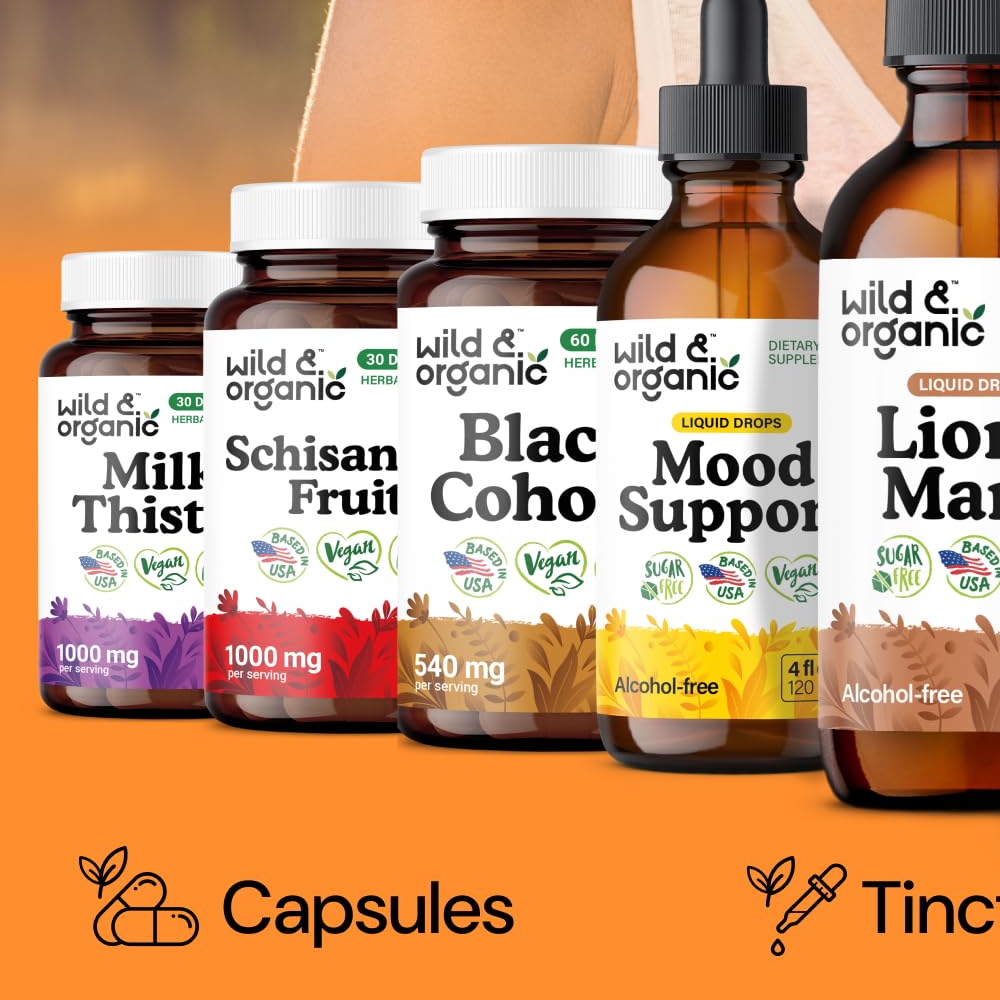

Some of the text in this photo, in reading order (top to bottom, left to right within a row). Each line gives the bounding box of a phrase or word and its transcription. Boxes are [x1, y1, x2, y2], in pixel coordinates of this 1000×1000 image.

[842, 281, 912, 314] wild
[416, 329, 481, 358] wild
[570, 334, 589, 346] 60
[841, 307, 985, 360] organic
[615, 334, 675, 363] wild
[769, 340, 818, 351] DIETARY
[227, 349, 286, 375] wild
[366, 354, 384, 365] 30
[416, 353, 548, 396] organic
[614, 357, 740, 402] organic
[226, 371, 345, 411] organic
[919, 379, 974, 393] LIQUID
[58, 393, 109, 415] wild
[177, 396, 192, 407] 30
[58, 411, 159, 445] organic
[682, 418, 781, 430] LIQUID DROPS
[653, 440, 814, 486] Mood
[271, 532, 304, 557] BASED
[324, 539, 375, 565] Vegan
[465, 542, 503, 566] BASED
[877, 543, 923, 567] SUGAR
[962, 541, 999, 565] BASED
[96, 550, 124, 570] BASED
[141, 556, 184, 577] Vegan
[270, 564, 296, 578] USA
[524, 550, 580, 578] Vegan
[645, 559, 685, 578] SUGAR
[719, 556, 753, 578] BASED
[94, 575, 117, 588] USA
[464, 578, 493, 592] USA
[773, 564, 818, 588] Vegan
[893, 569, 920, 592] FREE
[960, 576, 990, 592] USA
[660, 578, 683, 598] FREE
[718, 586, 743, 599] USA
[57, 644, 138, 668] 1000 mg
[225, 645, 321, 673] 1000 mg
[59, 664, 109, 676] per serving
[228, 669, 286, 683] per serving
[415, 653, 505, 685] 540 mg
[789, 659, 814, 676] 4 fl
[415, 680, 478, 695] per serving
[615, 676, 718, 695] Alcohol-free
[789, 681, 813, 695] 120
[842, 684, 963, 704] Alcohol-free
